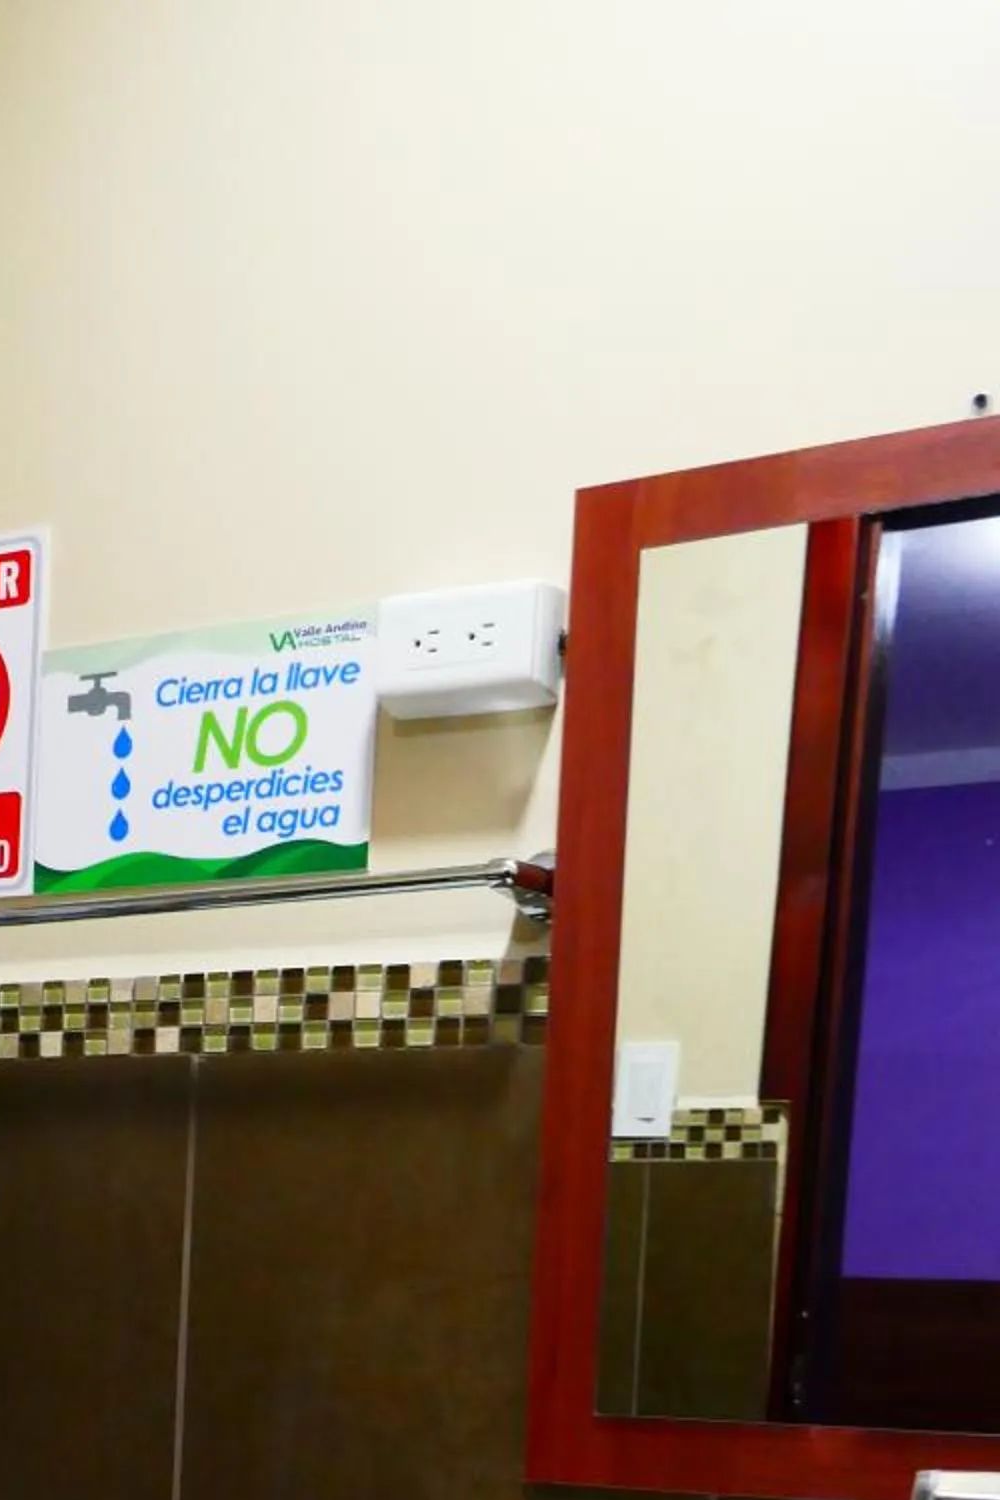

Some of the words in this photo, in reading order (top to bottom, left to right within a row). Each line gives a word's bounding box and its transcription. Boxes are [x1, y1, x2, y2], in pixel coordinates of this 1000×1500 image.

[294, 625, 322, 638] Valle
[155, 676, 244, 707] Cierra
[251, 667, 279, 697] la
[285, 660, 361, 692] llave
[192, 699, 309, 774] NO
[151, 764, 344, 812] desperdicies
[222, 806, 251, 836] el
[256, 803, 341, 839] agua
